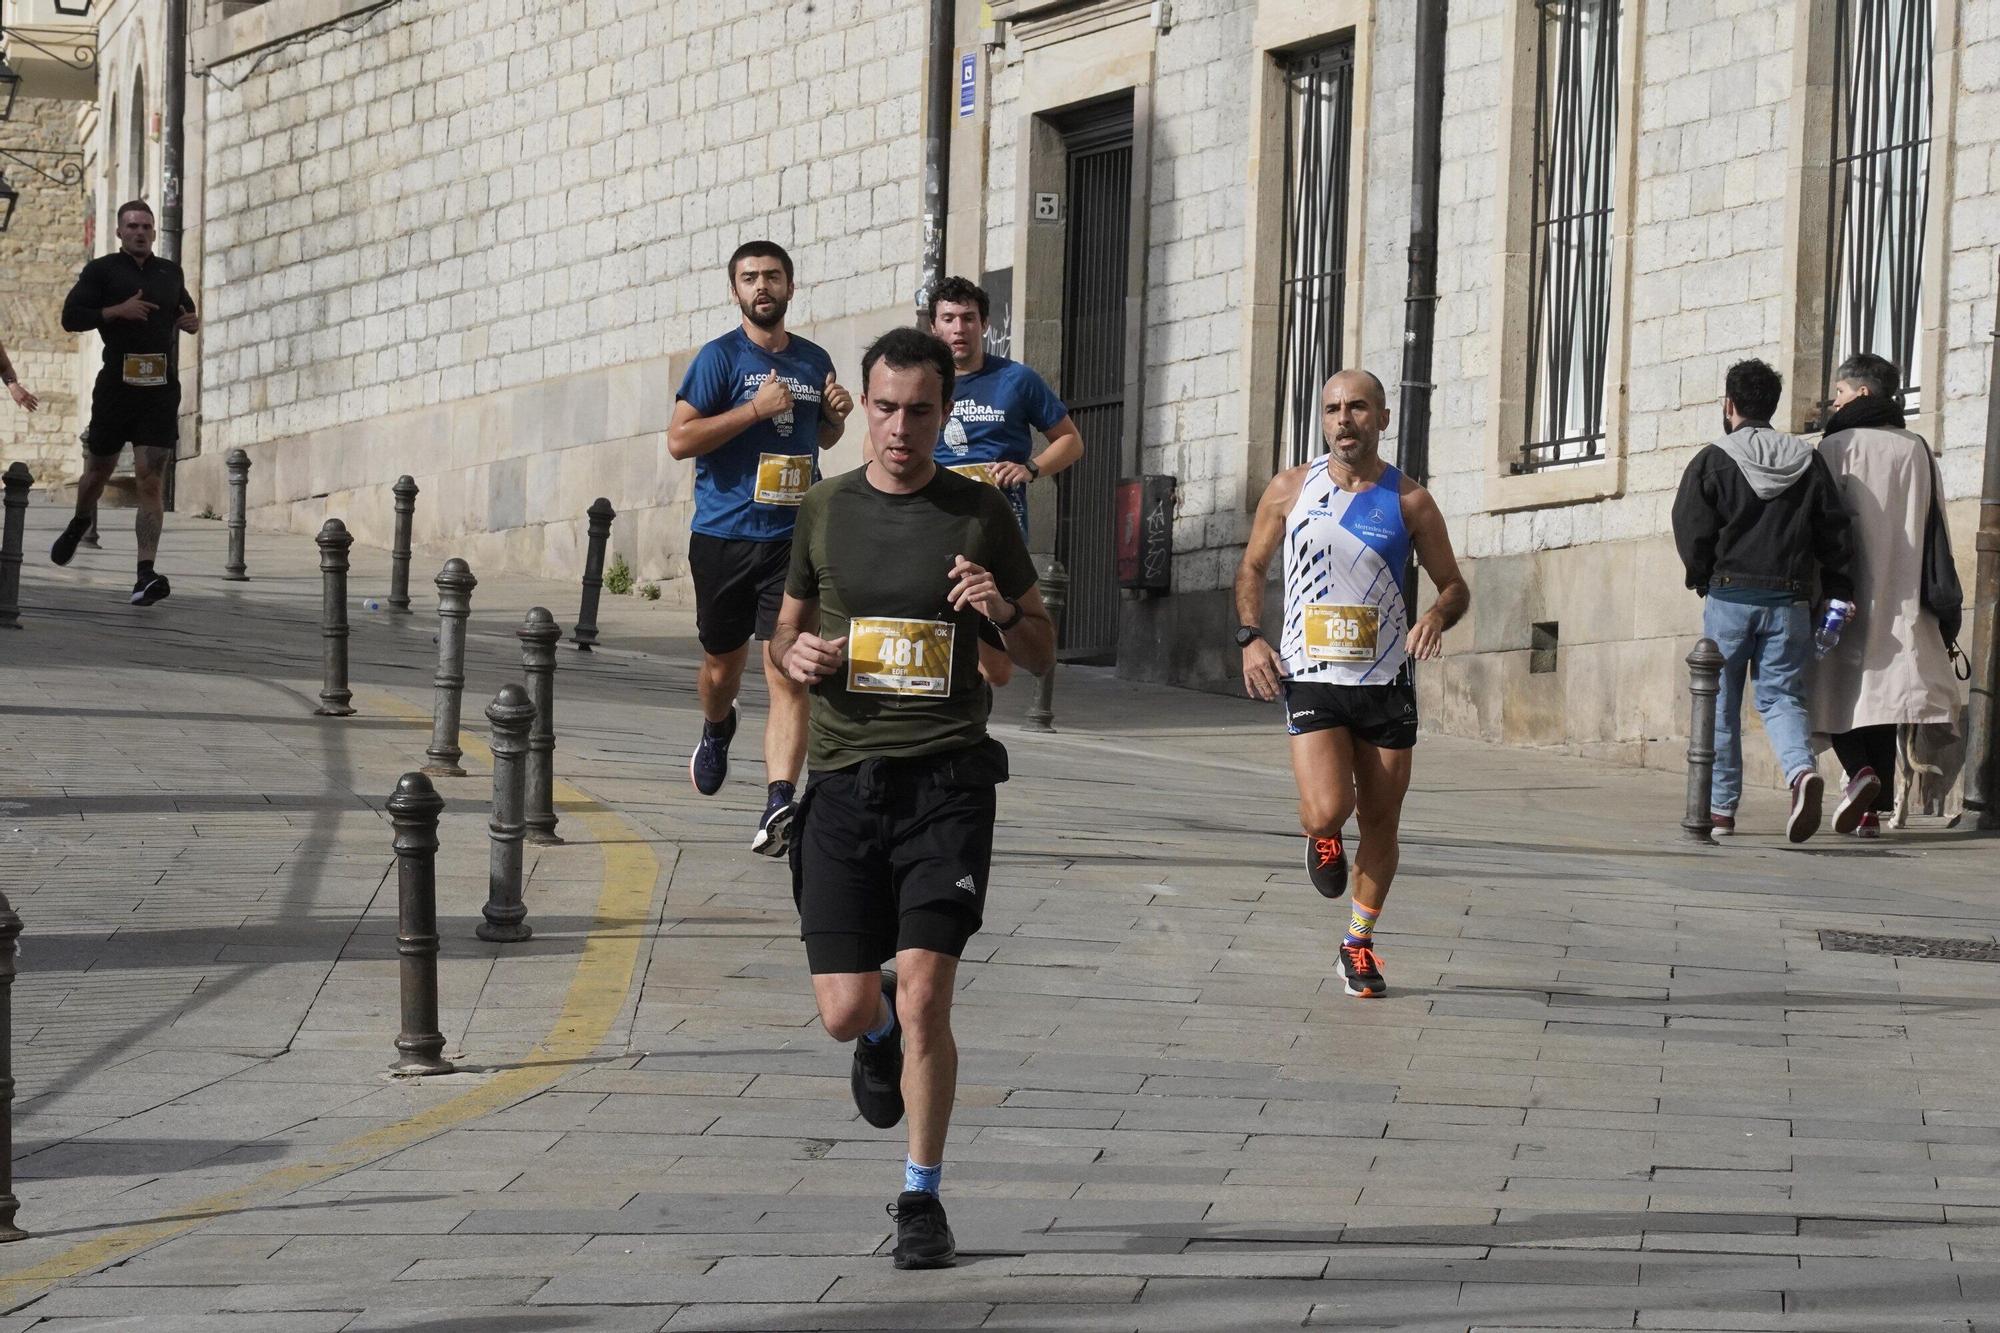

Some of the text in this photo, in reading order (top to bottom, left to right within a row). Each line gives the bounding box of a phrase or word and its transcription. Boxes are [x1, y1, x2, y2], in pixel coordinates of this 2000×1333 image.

[1040, 196, 1055, 216] 3
[744, 374, 755, 382] LA
[963, 414, 1005, 422] KONKISTA
[779, 468, 801, 487] 118
[1325, 619, 1359, 640] 135
[879, 638, 923, 666] 481
[955, 881, 976, 895] adidas
